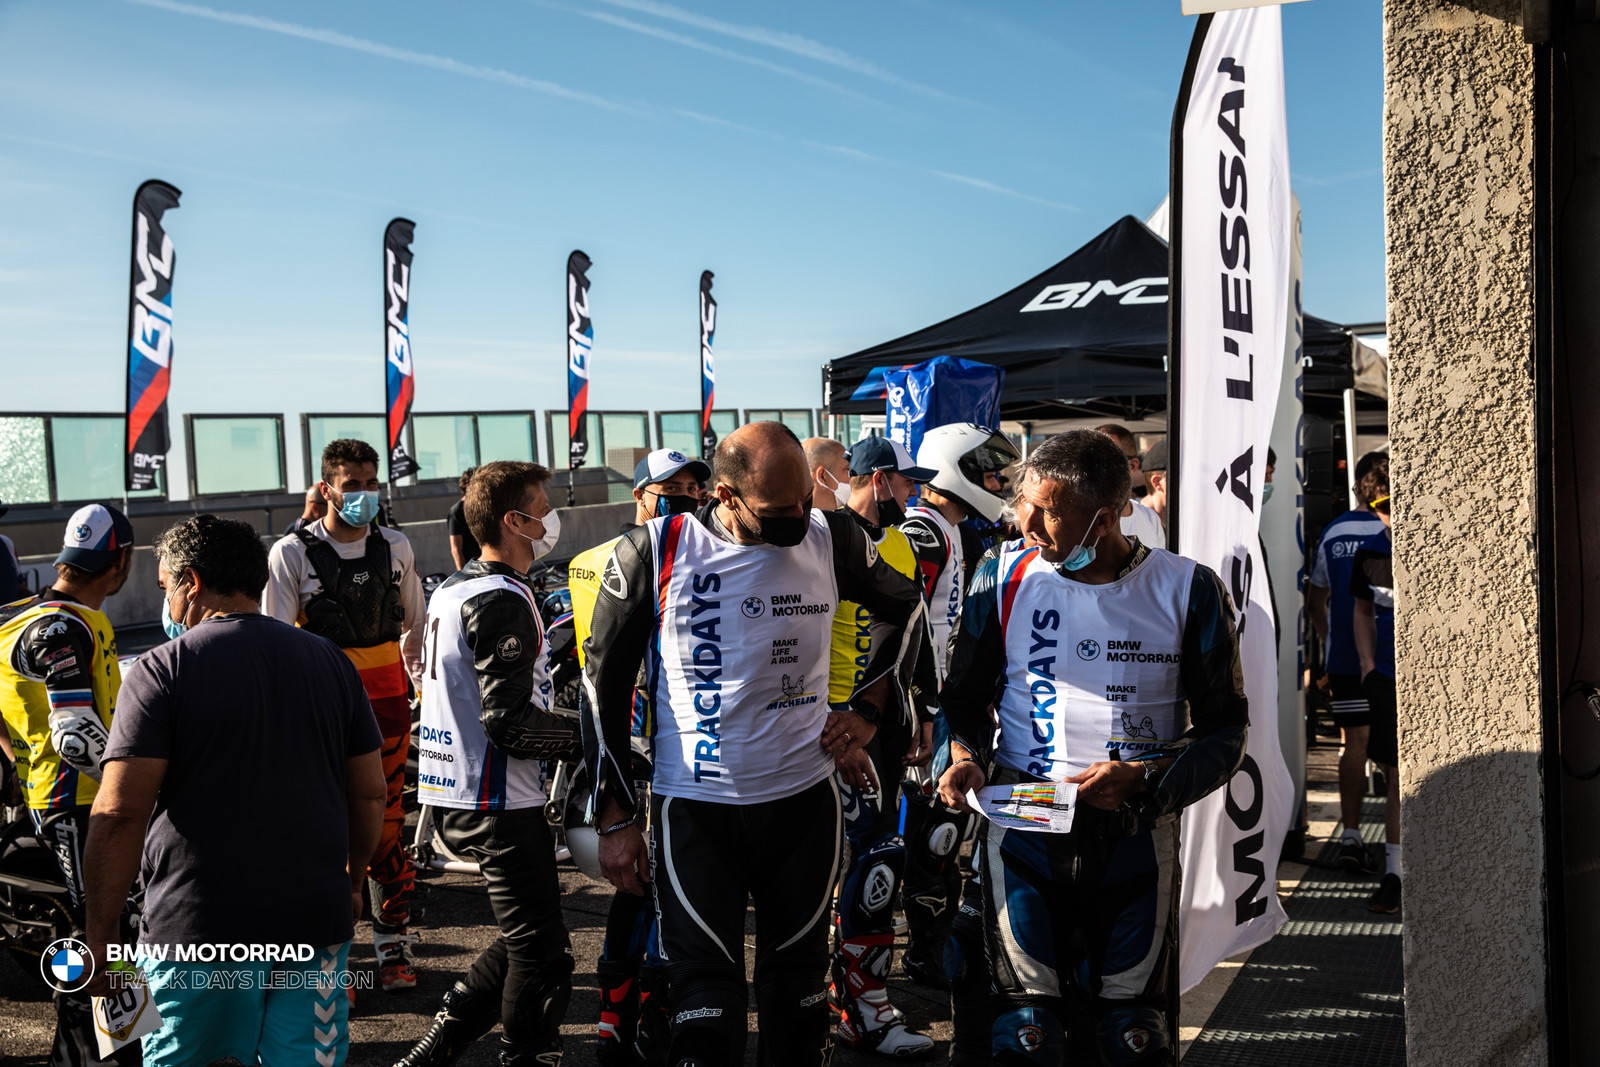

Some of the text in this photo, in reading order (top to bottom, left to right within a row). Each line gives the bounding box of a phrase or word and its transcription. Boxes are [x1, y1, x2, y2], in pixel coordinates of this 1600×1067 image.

[132, 211, 174, 368] BMC
[1019, 276, 1169, 313] BMC
[770, 594, 802, 606] BMW
[772, 603, 830, 617] MOTORRAD
[772, 638, 799, 648] MAKE
[1107, 640, 1142, 651] BMW
[771, 647, 790, 657] LIFE
[1106, 652, 1181, 664] MOTORRAD
[770, 656, 799, 665] A RIDE
[691, 572, 722, 783] TRACKDAYS
[1106, 685, 1137, 694] MAKE
[766, 695, 818, 711] MICHELIN
[1106, 694, 1128, 702] LIFE
